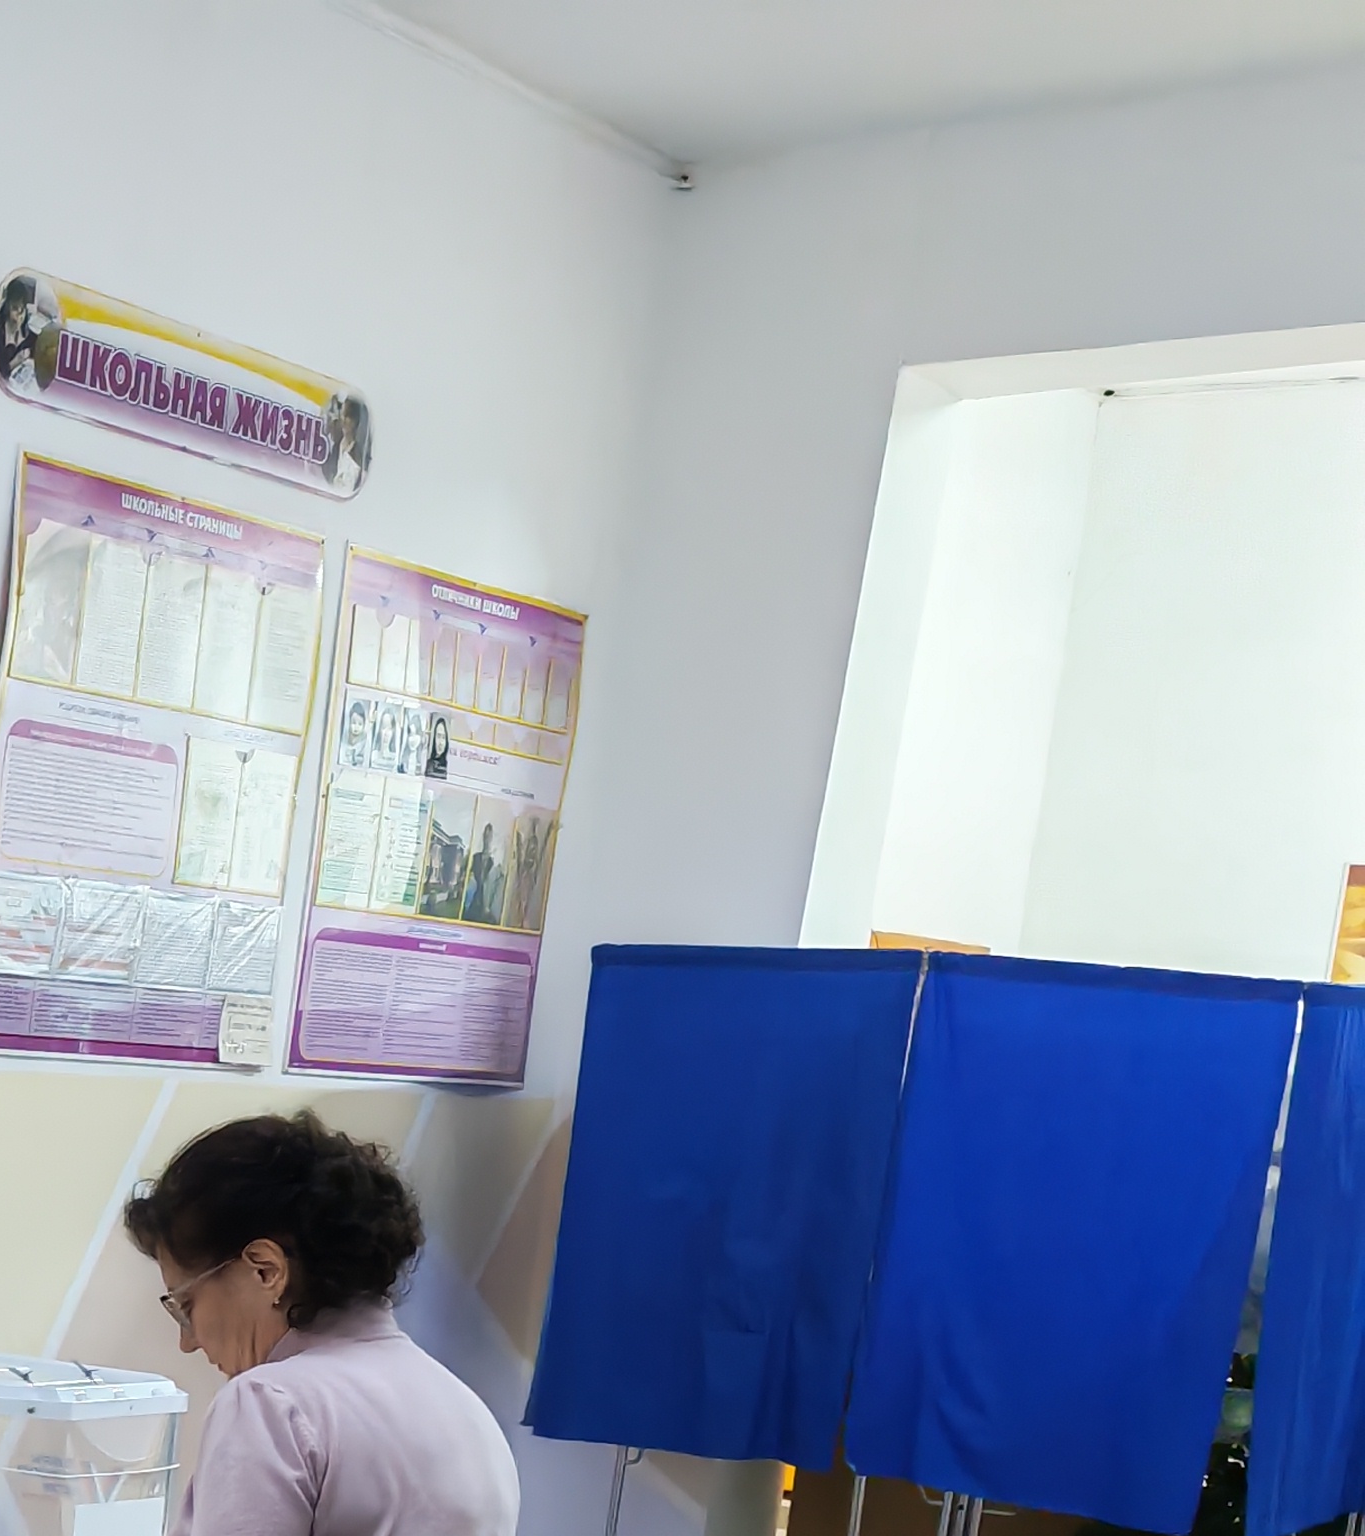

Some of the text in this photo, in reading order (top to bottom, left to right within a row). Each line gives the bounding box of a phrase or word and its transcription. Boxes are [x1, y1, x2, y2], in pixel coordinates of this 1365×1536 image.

[55, 330, 331, 465] ШКОЛЬНАЯ ЖИЗНЬ
[121, 492, 244, 541] ШКОЛЬНЫЕ СТРАНИЦЫ
[482, 598, 521, 621] ШКОЛЫ
